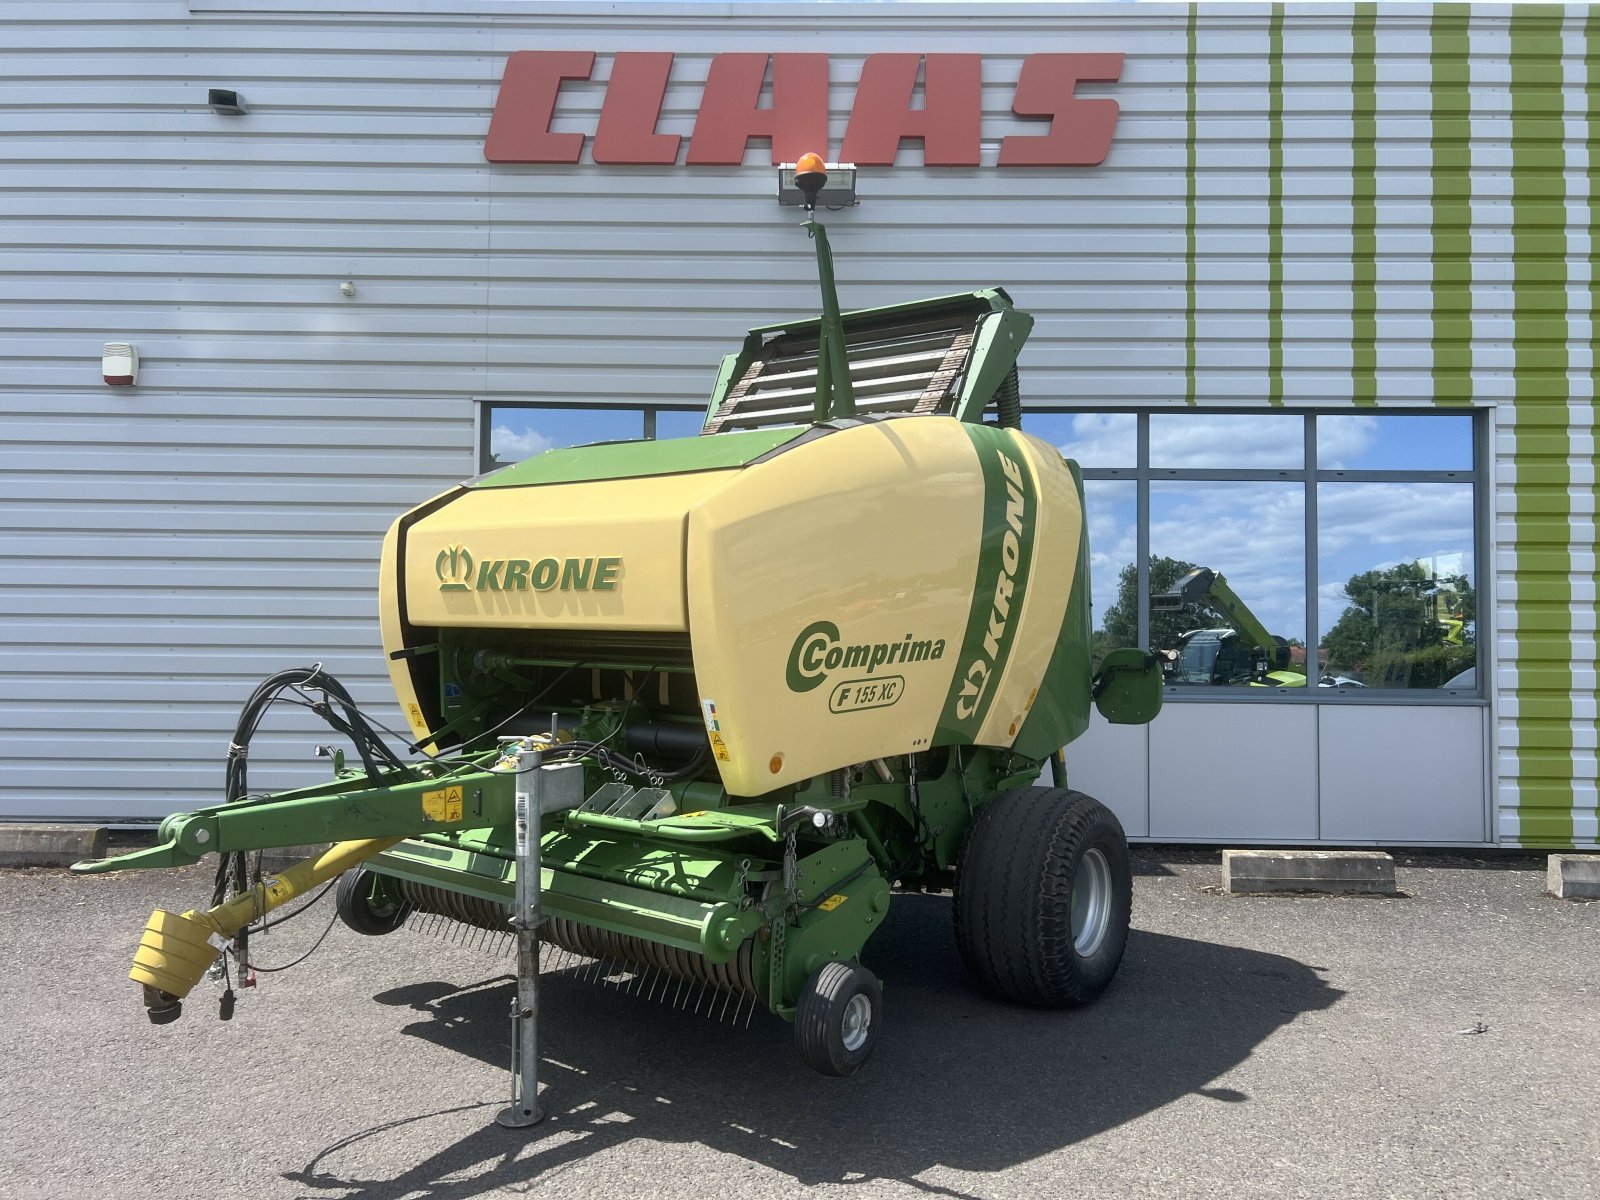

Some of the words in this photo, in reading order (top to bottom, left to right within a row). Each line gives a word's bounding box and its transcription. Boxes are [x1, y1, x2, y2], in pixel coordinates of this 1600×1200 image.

[484, 51, 1125, 166] CLAAS
[476, 556, 622, 592] KRONE
[983, 449, 1025, 661] KRONE
[786, 620, 946, 693] Comprima
[837, 688, 851, 706] F
[855, 686, 877, 704] 155
[878, 682, 896, 700] XC
